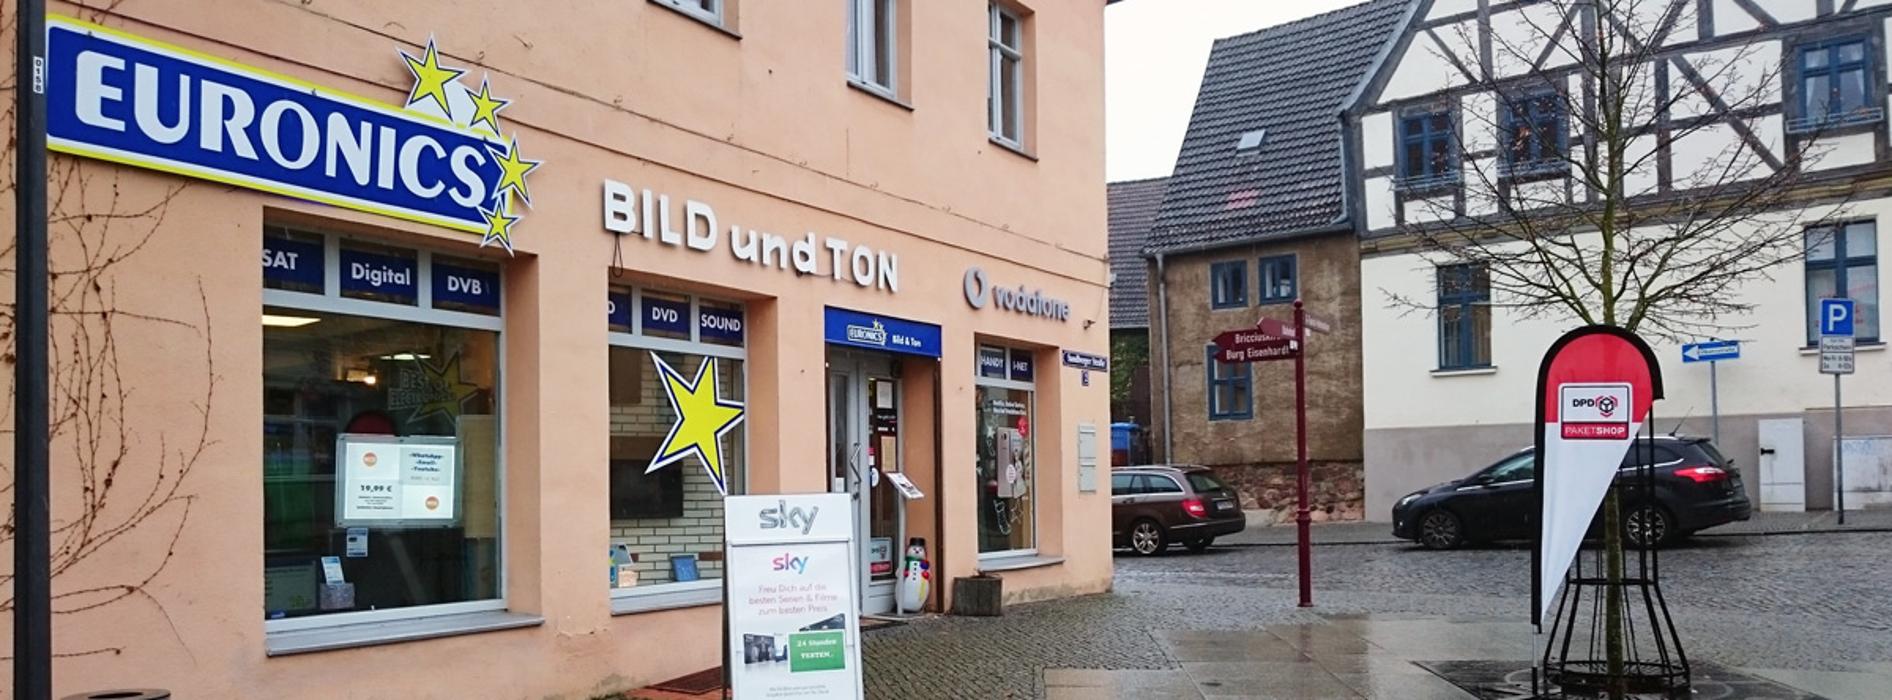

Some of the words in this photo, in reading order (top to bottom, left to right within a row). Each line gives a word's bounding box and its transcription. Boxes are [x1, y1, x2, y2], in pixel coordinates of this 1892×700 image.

[76, 49, 487, 208] EURONICS
[604, 179, 718, 252] BILD
[731, 224, 818, 274] und
[825, 236, 898, 293] TON
[262, 249, 298, 270] SAT
[351, 262, 411, 287] Digital
[447, 276, 482, 295] DVB
[993, 285, 1072, 322] vodafone
[652, 306, 679, 322] DVD
[701, 314, 741, 331] SOUND
[1829, 304, 1847, 332] P
[848, 327, 883, 342] EURONICS
[892, 335, 905, 344] Bild
[905, 337, 910, 346] &
[911, 337, 922, 347] Ton
[981, 355, 1004, 368] HANDY
[1226, 349, 1245, 360] Burg
[1572, 398, 1595, 407] DPD
[1564, 426, 1625, 435] PAKETSHOP
[361, 484, 383, 493] 19,99
[386, 485, 393, 493] €
[759, 500, 819, 535] sky
[772, 552, 809, 574] sky
[778, 583, 798, 593] Dich
[799, 583, 813, 592] auf
[748, 595, 777, 605] besten
[759, 607, 777, 616] zum
[778, 606, 806, 615] besten
[808, 604, 828, 613] Preis
[808, 638, 837, 646] Stunden
